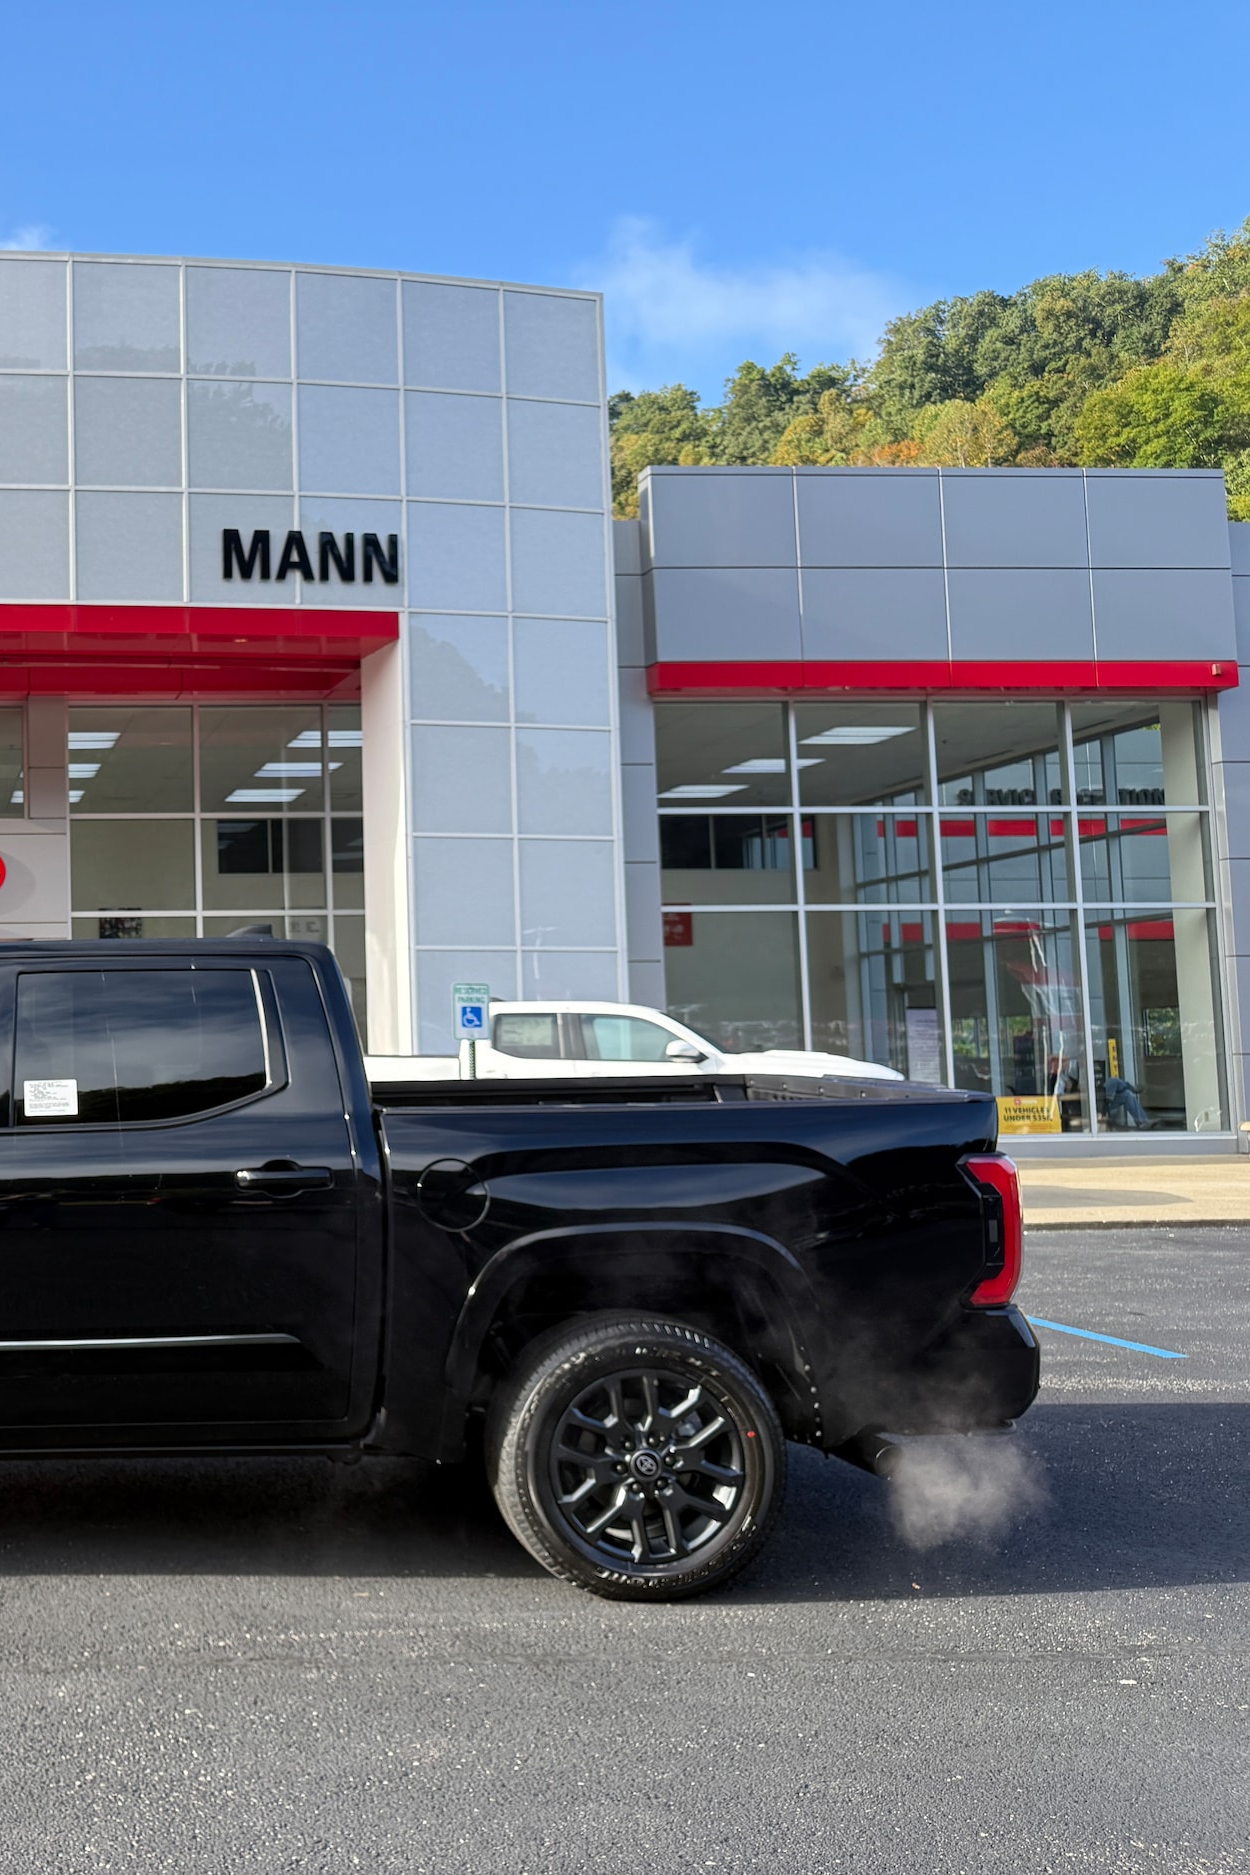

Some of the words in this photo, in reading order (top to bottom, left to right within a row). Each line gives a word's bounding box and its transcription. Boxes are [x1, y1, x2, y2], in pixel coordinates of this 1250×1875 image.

[222, 528, 399, 583] MANN
[1004, 1106, 1012, 1114] 11
[1013, 1106, 1050, 1115] VEHICLES
